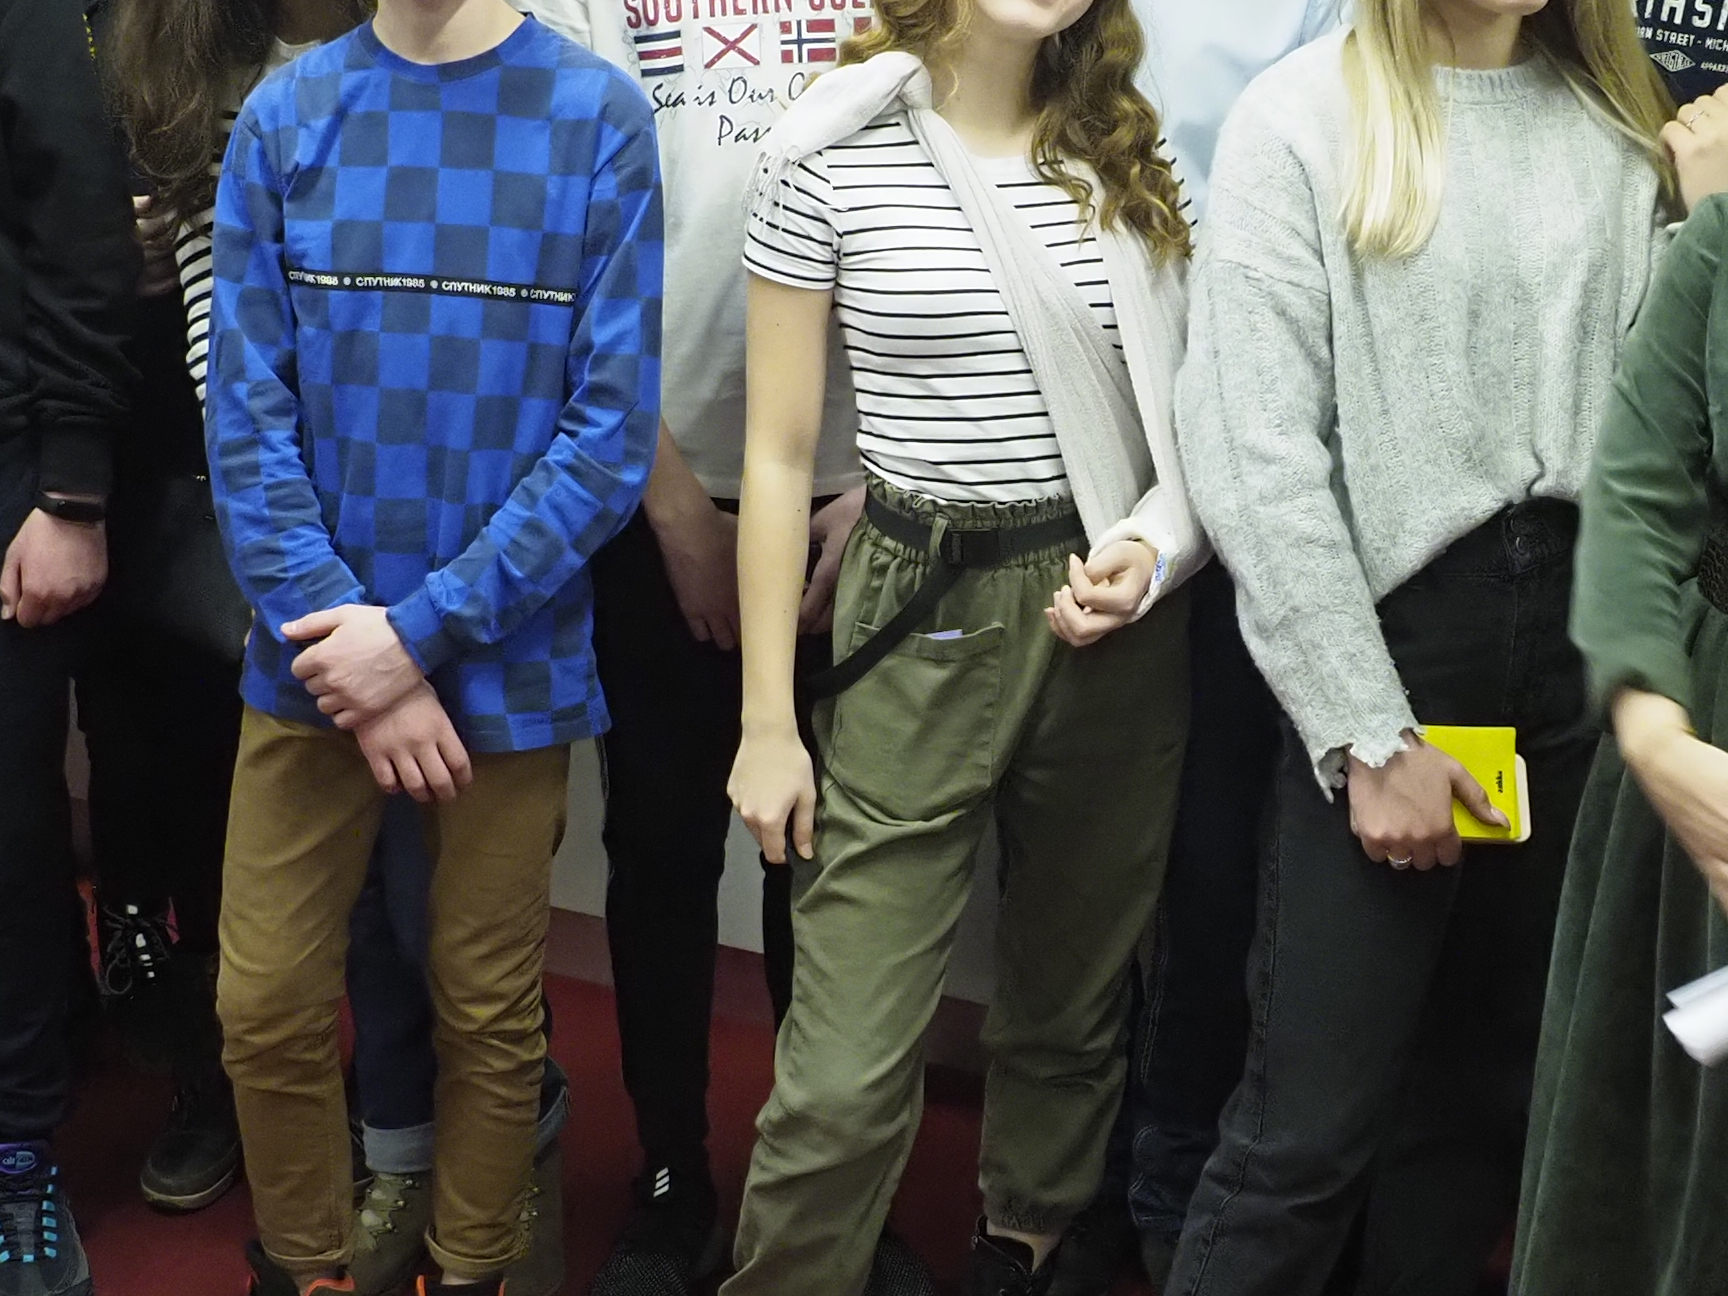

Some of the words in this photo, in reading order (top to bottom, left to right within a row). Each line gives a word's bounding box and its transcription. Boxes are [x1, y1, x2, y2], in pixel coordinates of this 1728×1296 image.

[1656, 29, 1696, 48] STREET
[355, 276, 426, 288] СПУТНИК1985
[441, 281, 516, 298] СПУТНИК1985
